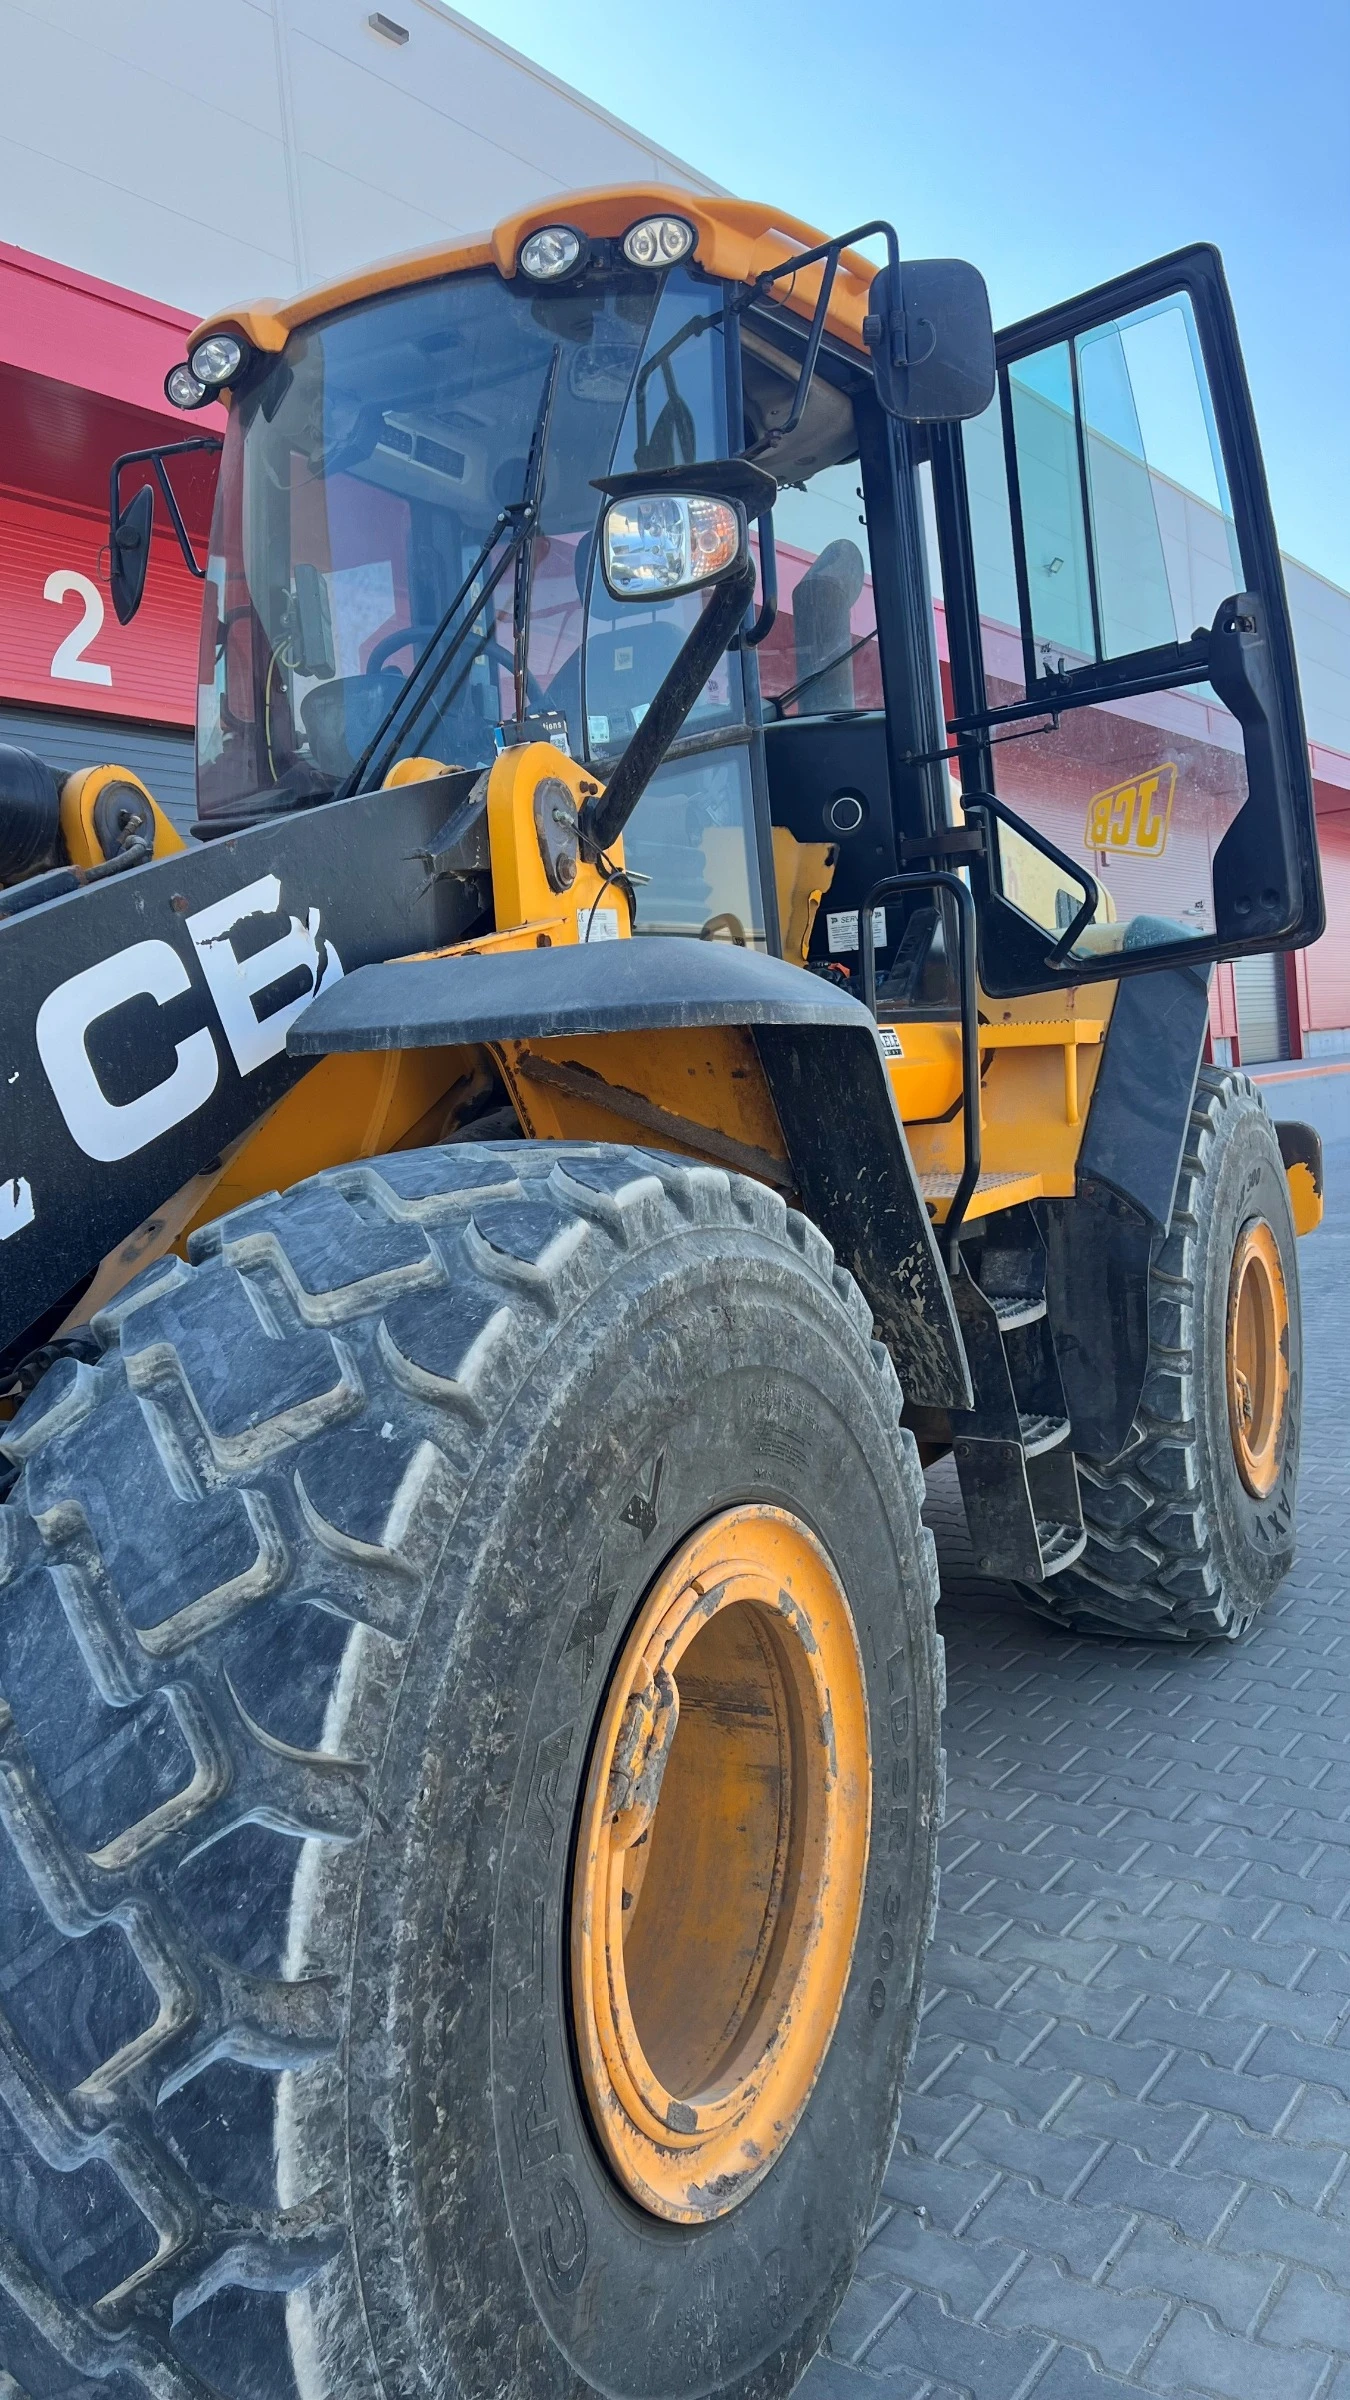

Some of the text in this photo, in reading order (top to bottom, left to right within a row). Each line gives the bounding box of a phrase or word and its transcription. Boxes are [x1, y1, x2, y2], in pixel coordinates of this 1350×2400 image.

[43, 569, 112, 687] 2
[841, 914, 859, 924] SERV
[0, 873, 345, 1240] CB
[867, 1883, 901, 2020] 300
